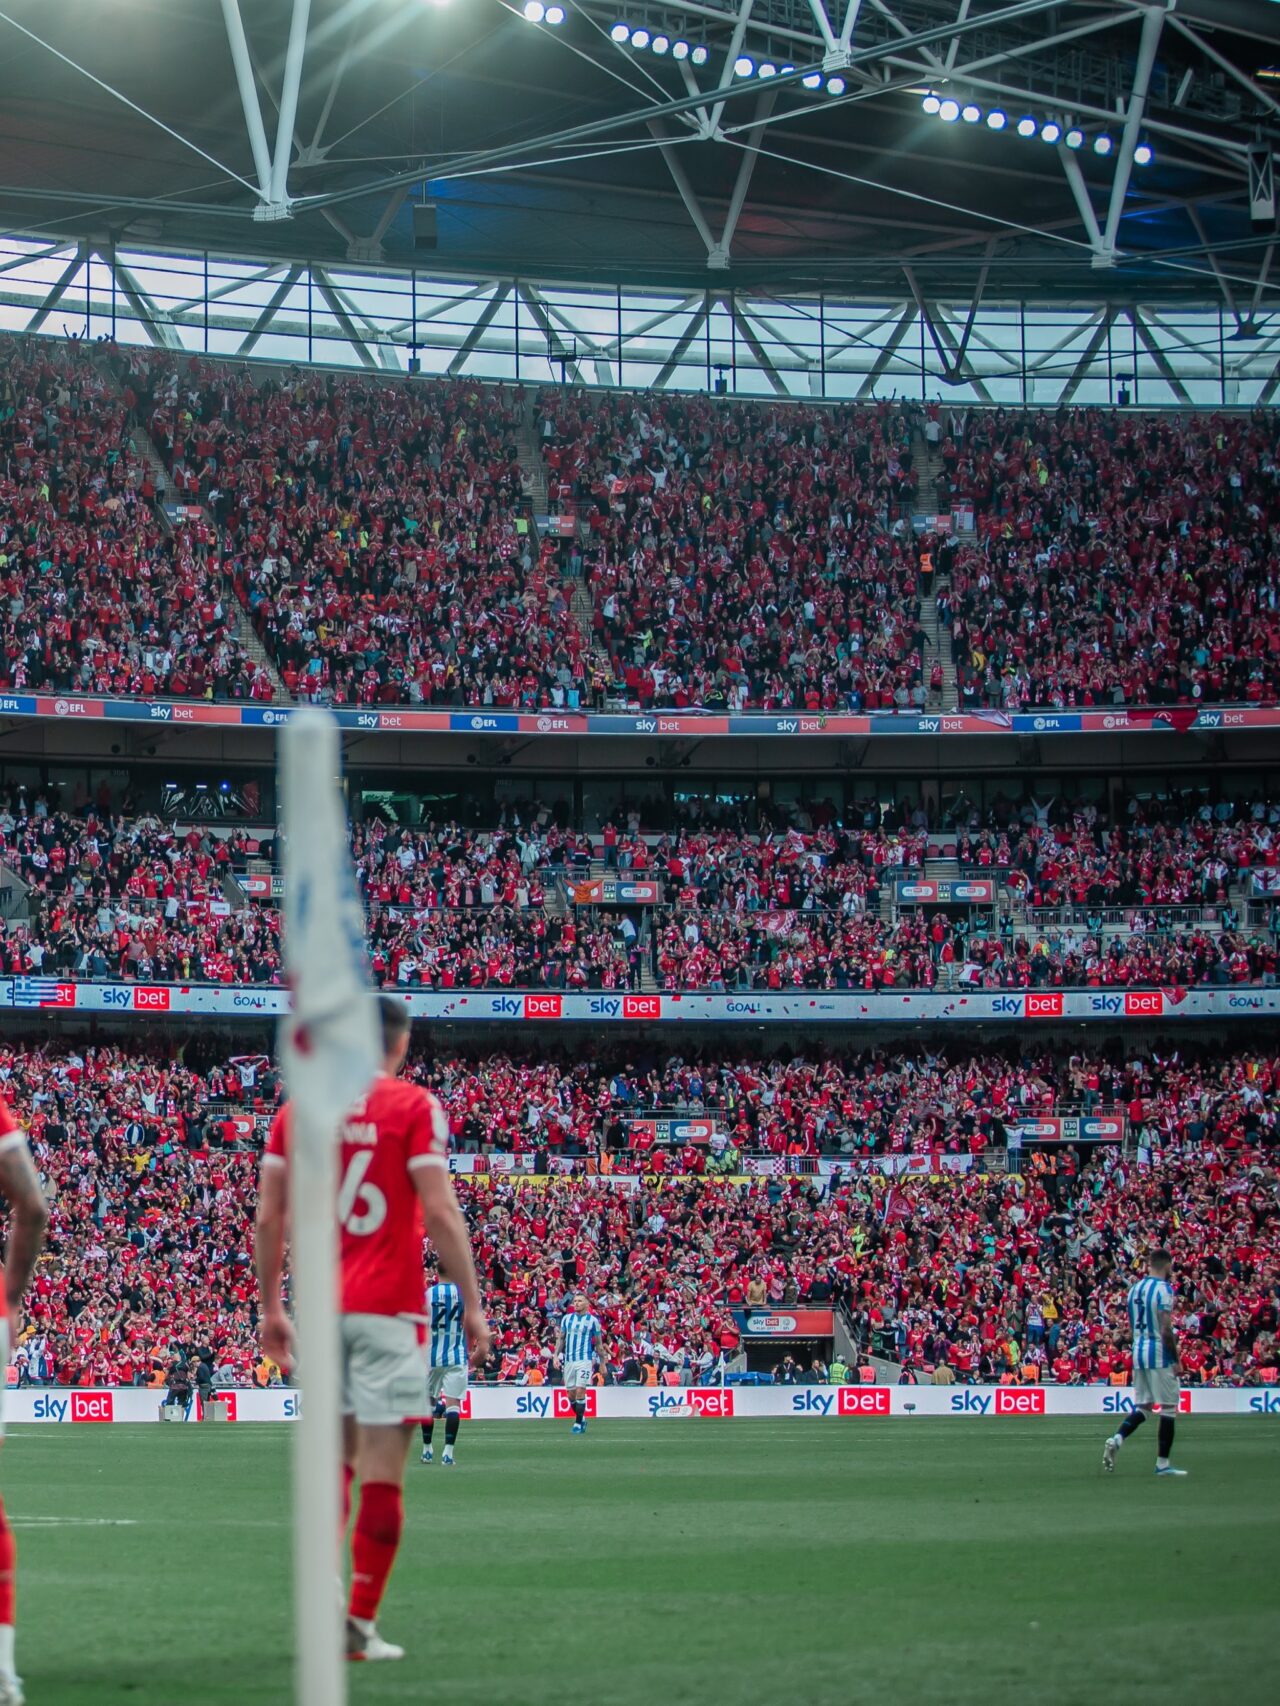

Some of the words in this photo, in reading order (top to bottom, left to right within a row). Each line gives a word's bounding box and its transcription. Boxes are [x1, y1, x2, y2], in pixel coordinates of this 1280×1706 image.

[3, 699, 19, 710] EFL
[70, 703, 86, 713] EFL
[151, 705, 170, 720] sky
[174, 707, 193, 718] bet
[275, 713, 288, 721] EFL
[1200, 711, 1220, 725] sky
[1223, 712, 1243, 723] bet
[358, 714, 378, 729] sky
[381, 715, 401, 725] bet
[483, 719, 497, 727] EFL
[552, 719, 568, 728] EFL
[635, 719, 656, 733] sky
[659, 720, 679, 730] bet
[777, 719, 797, 733] sky
[801, 719, 821, 730] bet
[918, 718, 939, 733] sky
[942, 719, 962, 730] bet
[1046, 719, 1059, 727] EFL
[56, 988, 72, 1002] et
[103, 988, 131, 1008] sky
[138, 989, 166, 1006] bet
[233, 997, 266, 1008] GOAL!
[491, 997, 521, 1015] sky
[528, 997, 557, 1013] bet
[590, 998, 620, 1015] sky
[626, 997, 656, 1013] bet
[726, 1002, 760, 1013] GOAL!
[992, 996, 1022, 1014] sky
[1028, 996, 1058, 1011] bet
[1091, 995, 1122, 1013] sky
[1128, 994, 1158, 1010] bet
[1229, 997, 1263, 1008] GOAL!
[430, 1301, 464, 1330] 24
[766, 1318, 779, 1326] bet
[580, 1370, 589, 1379] 25
[33, 1395, 67, 1421] sky
[76, 1393, 108, 1413] bet
[516, 1392, 550, 1417] sky
[558, 1391, 592, 1411] bt
[692, 1392, 728, 1412] bet
[792, 1390, 834, 1415] sky
[843, 1391, 885, 1411] bet
[951, 1390, 992, 1414] sky
[1000, 1391, 1040, 1411] bet
[1249, 1391, 1280, 1413] sk
